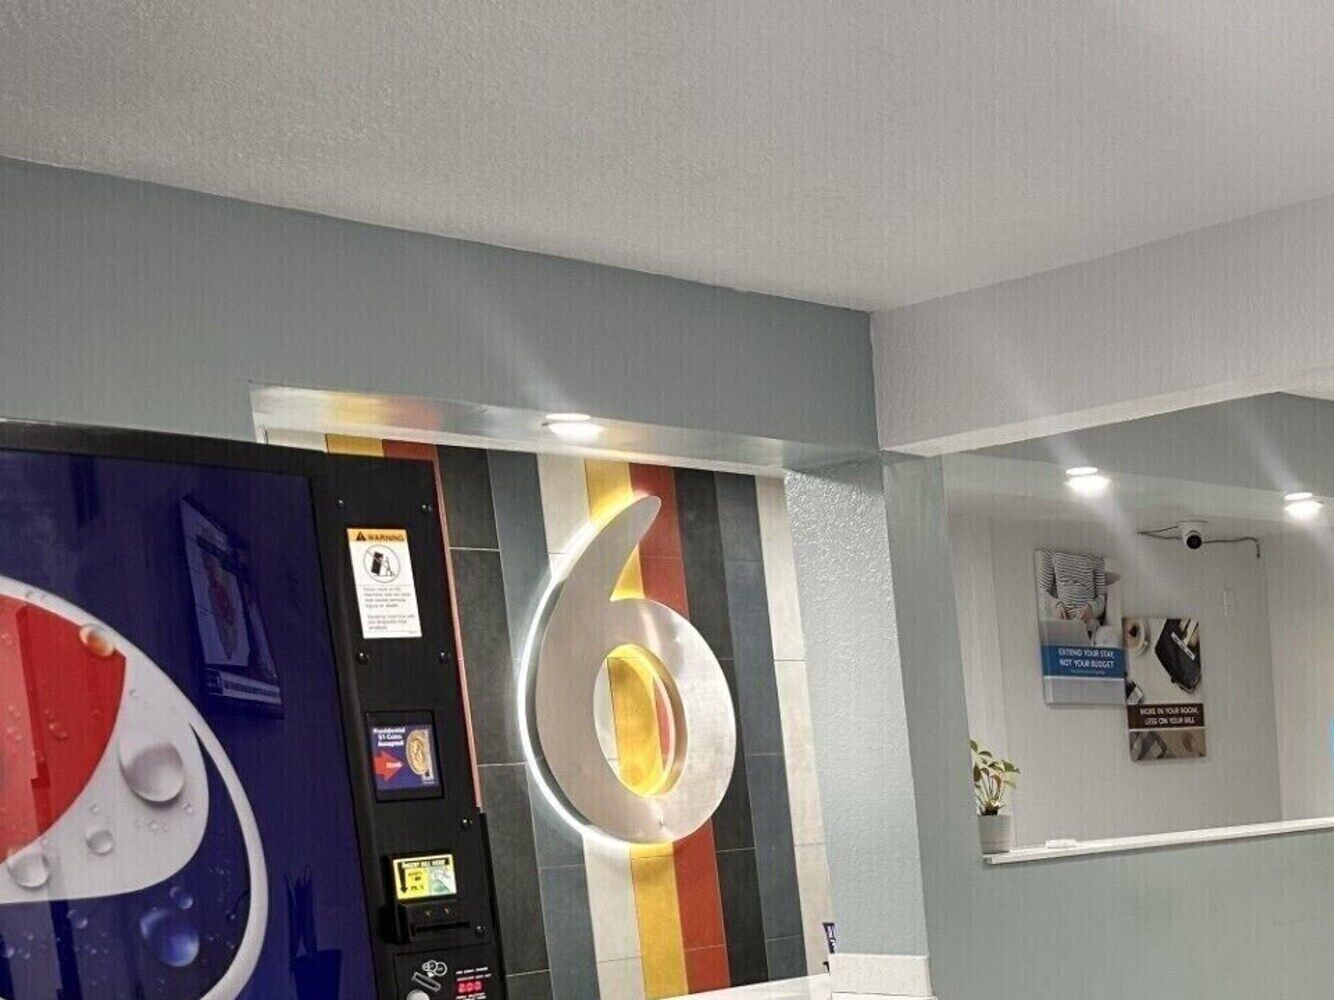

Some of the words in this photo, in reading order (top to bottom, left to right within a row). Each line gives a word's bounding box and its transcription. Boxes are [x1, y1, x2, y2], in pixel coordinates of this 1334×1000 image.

[367, 533, 405, 542] WARNING
[1058, 648, 1082, 656] EXTEND
[1091, 660, 1115, 668] BUDGET
[532, 494, 736, 843] 6
[1165, 707, 1180, 715] YOUR
[1169, 716, 1183, 724] YOUR
